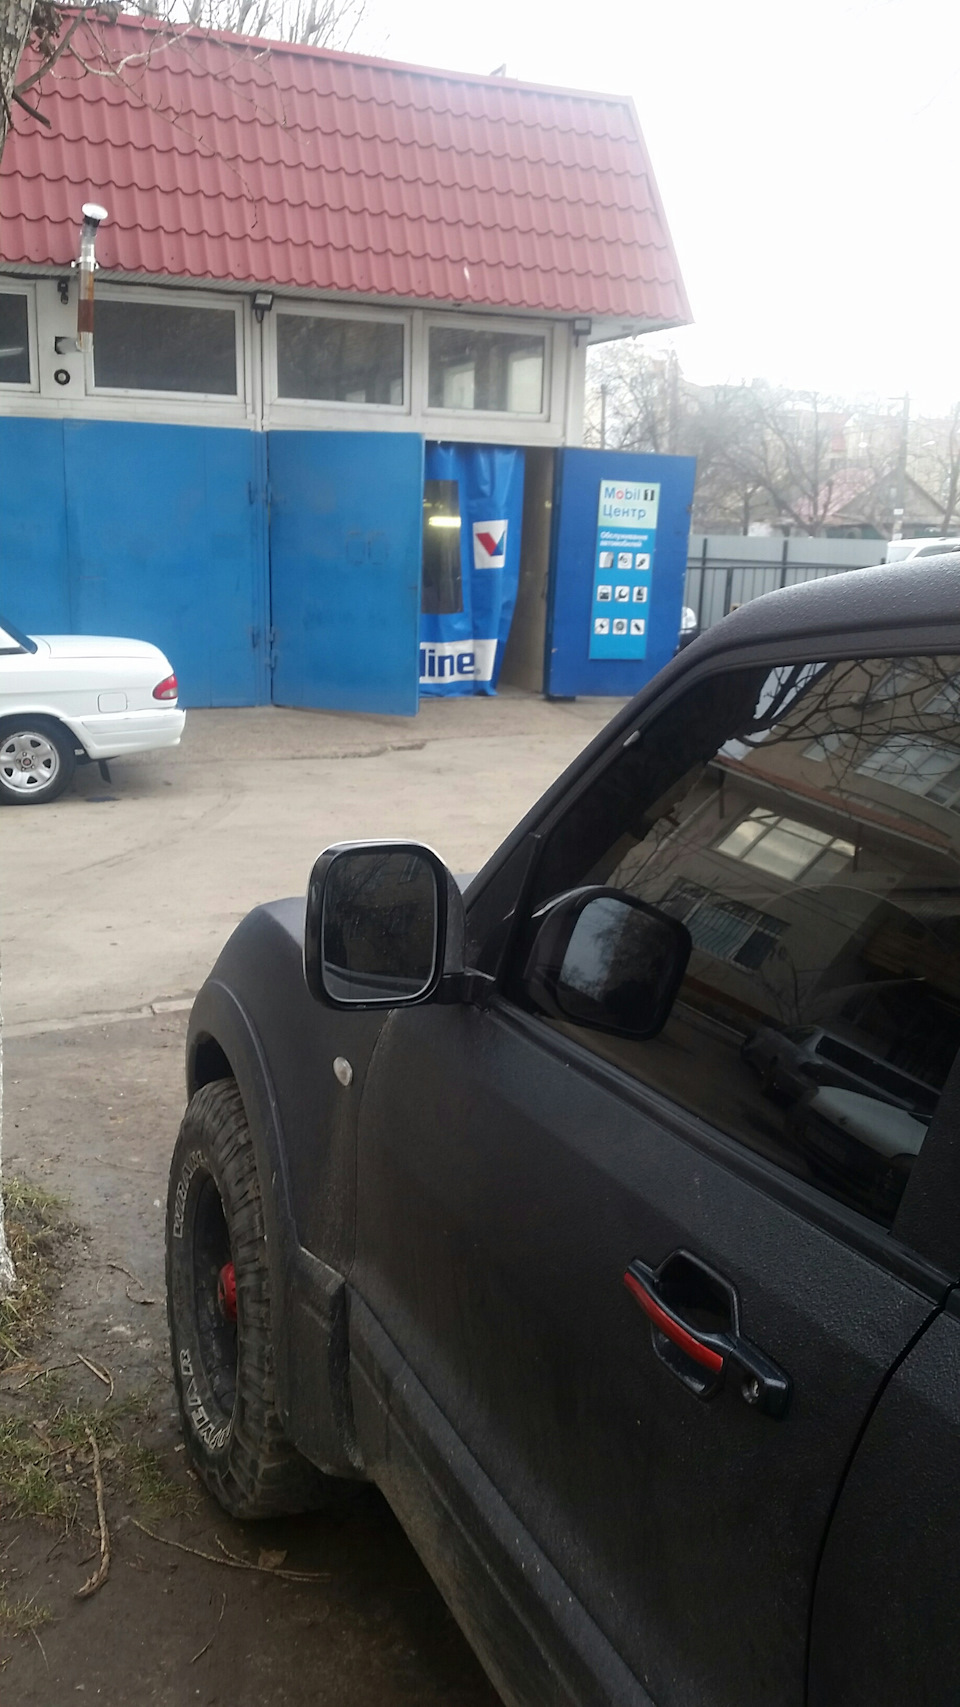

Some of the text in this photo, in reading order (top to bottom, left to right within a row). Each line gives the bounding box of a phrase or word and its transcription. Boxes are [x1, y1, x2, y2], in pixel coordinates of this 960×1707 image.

[604, 487, 655, 501] Mobil 1
[603, 504, 646, 520] Центр
[419, 649, 475, 677] line
